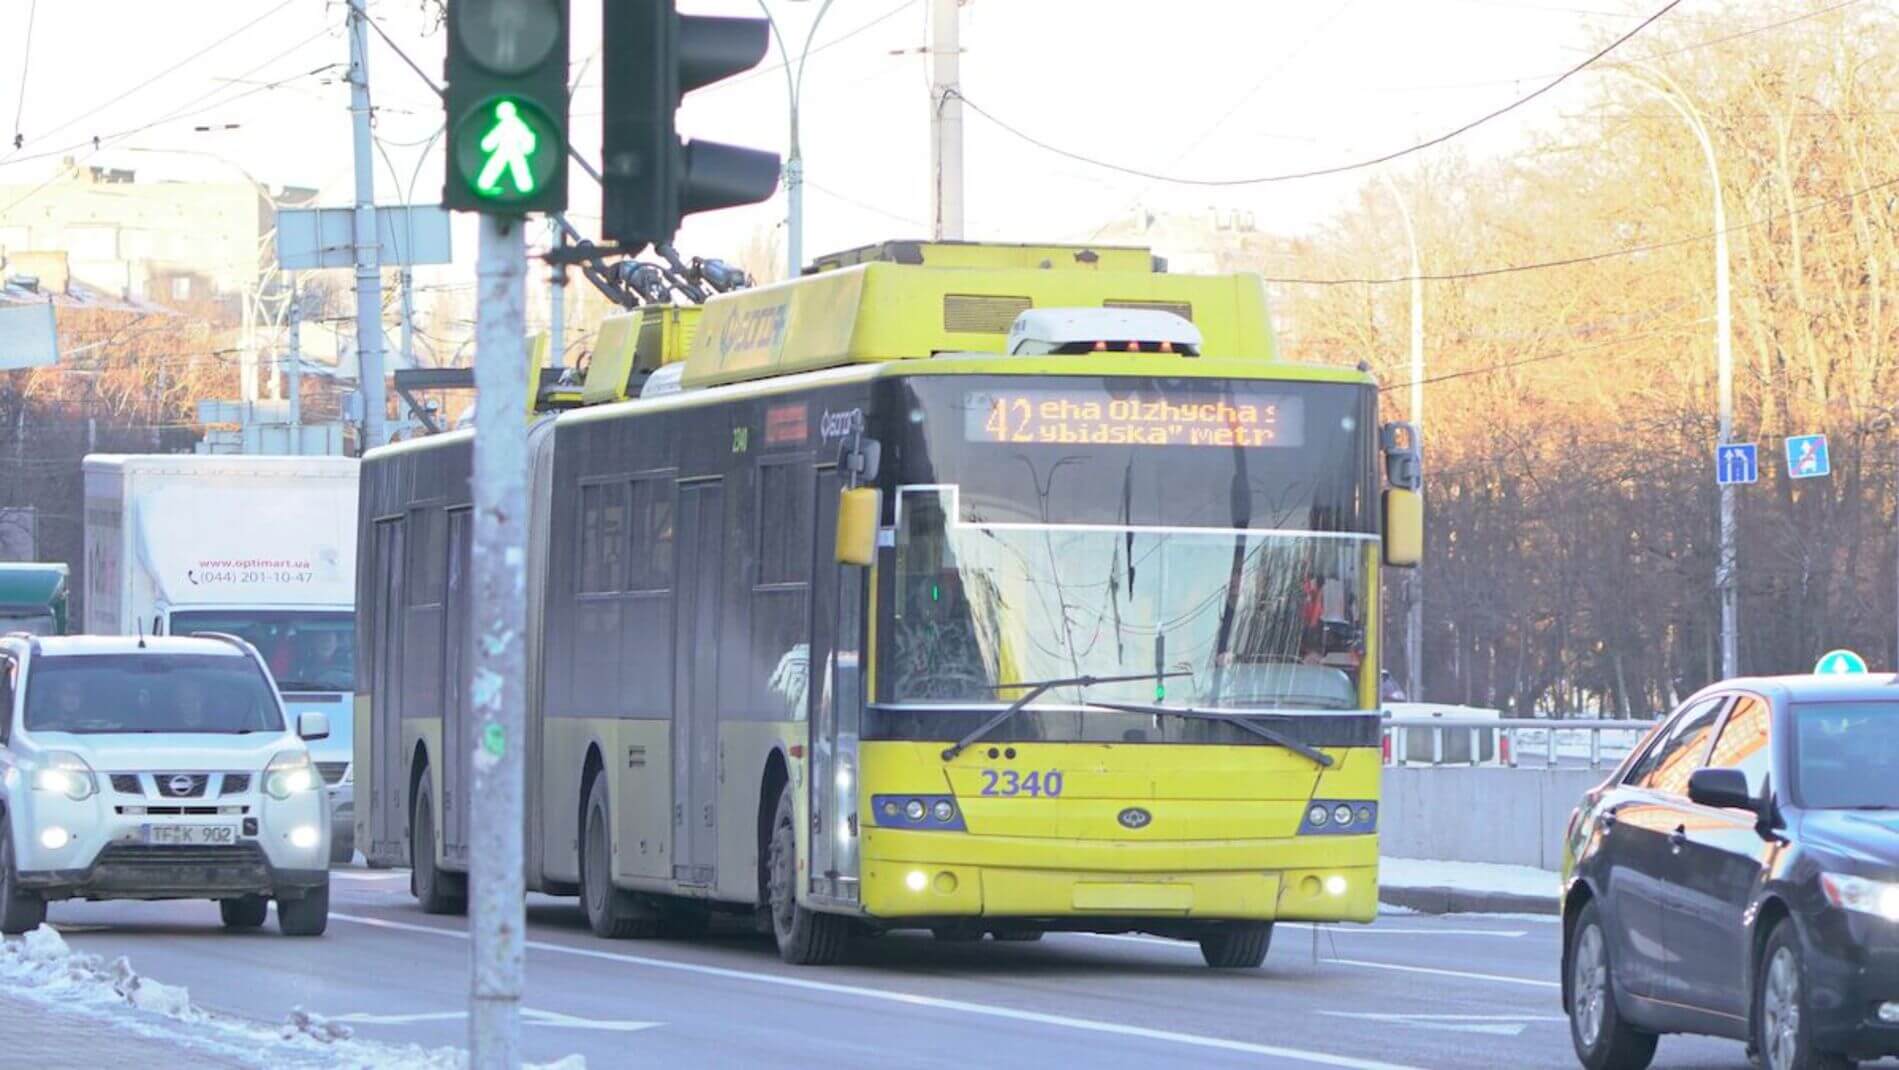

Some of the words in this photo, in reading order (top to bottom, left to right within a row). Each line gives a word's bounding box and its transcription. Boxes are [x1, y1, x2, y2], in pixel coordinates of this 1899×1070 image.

[986, 397, 1033, 442] 42
[1109, 400, 1257, 423] Olzhycha
[200, 559, 310, 569] www.optimart.ua
[200, 571, 236, 583] (044)
[240, 571, 313, 583] 201-10-47
[981, 769, 1063, 797] 2340
[202, 826, 232, 843] 902
